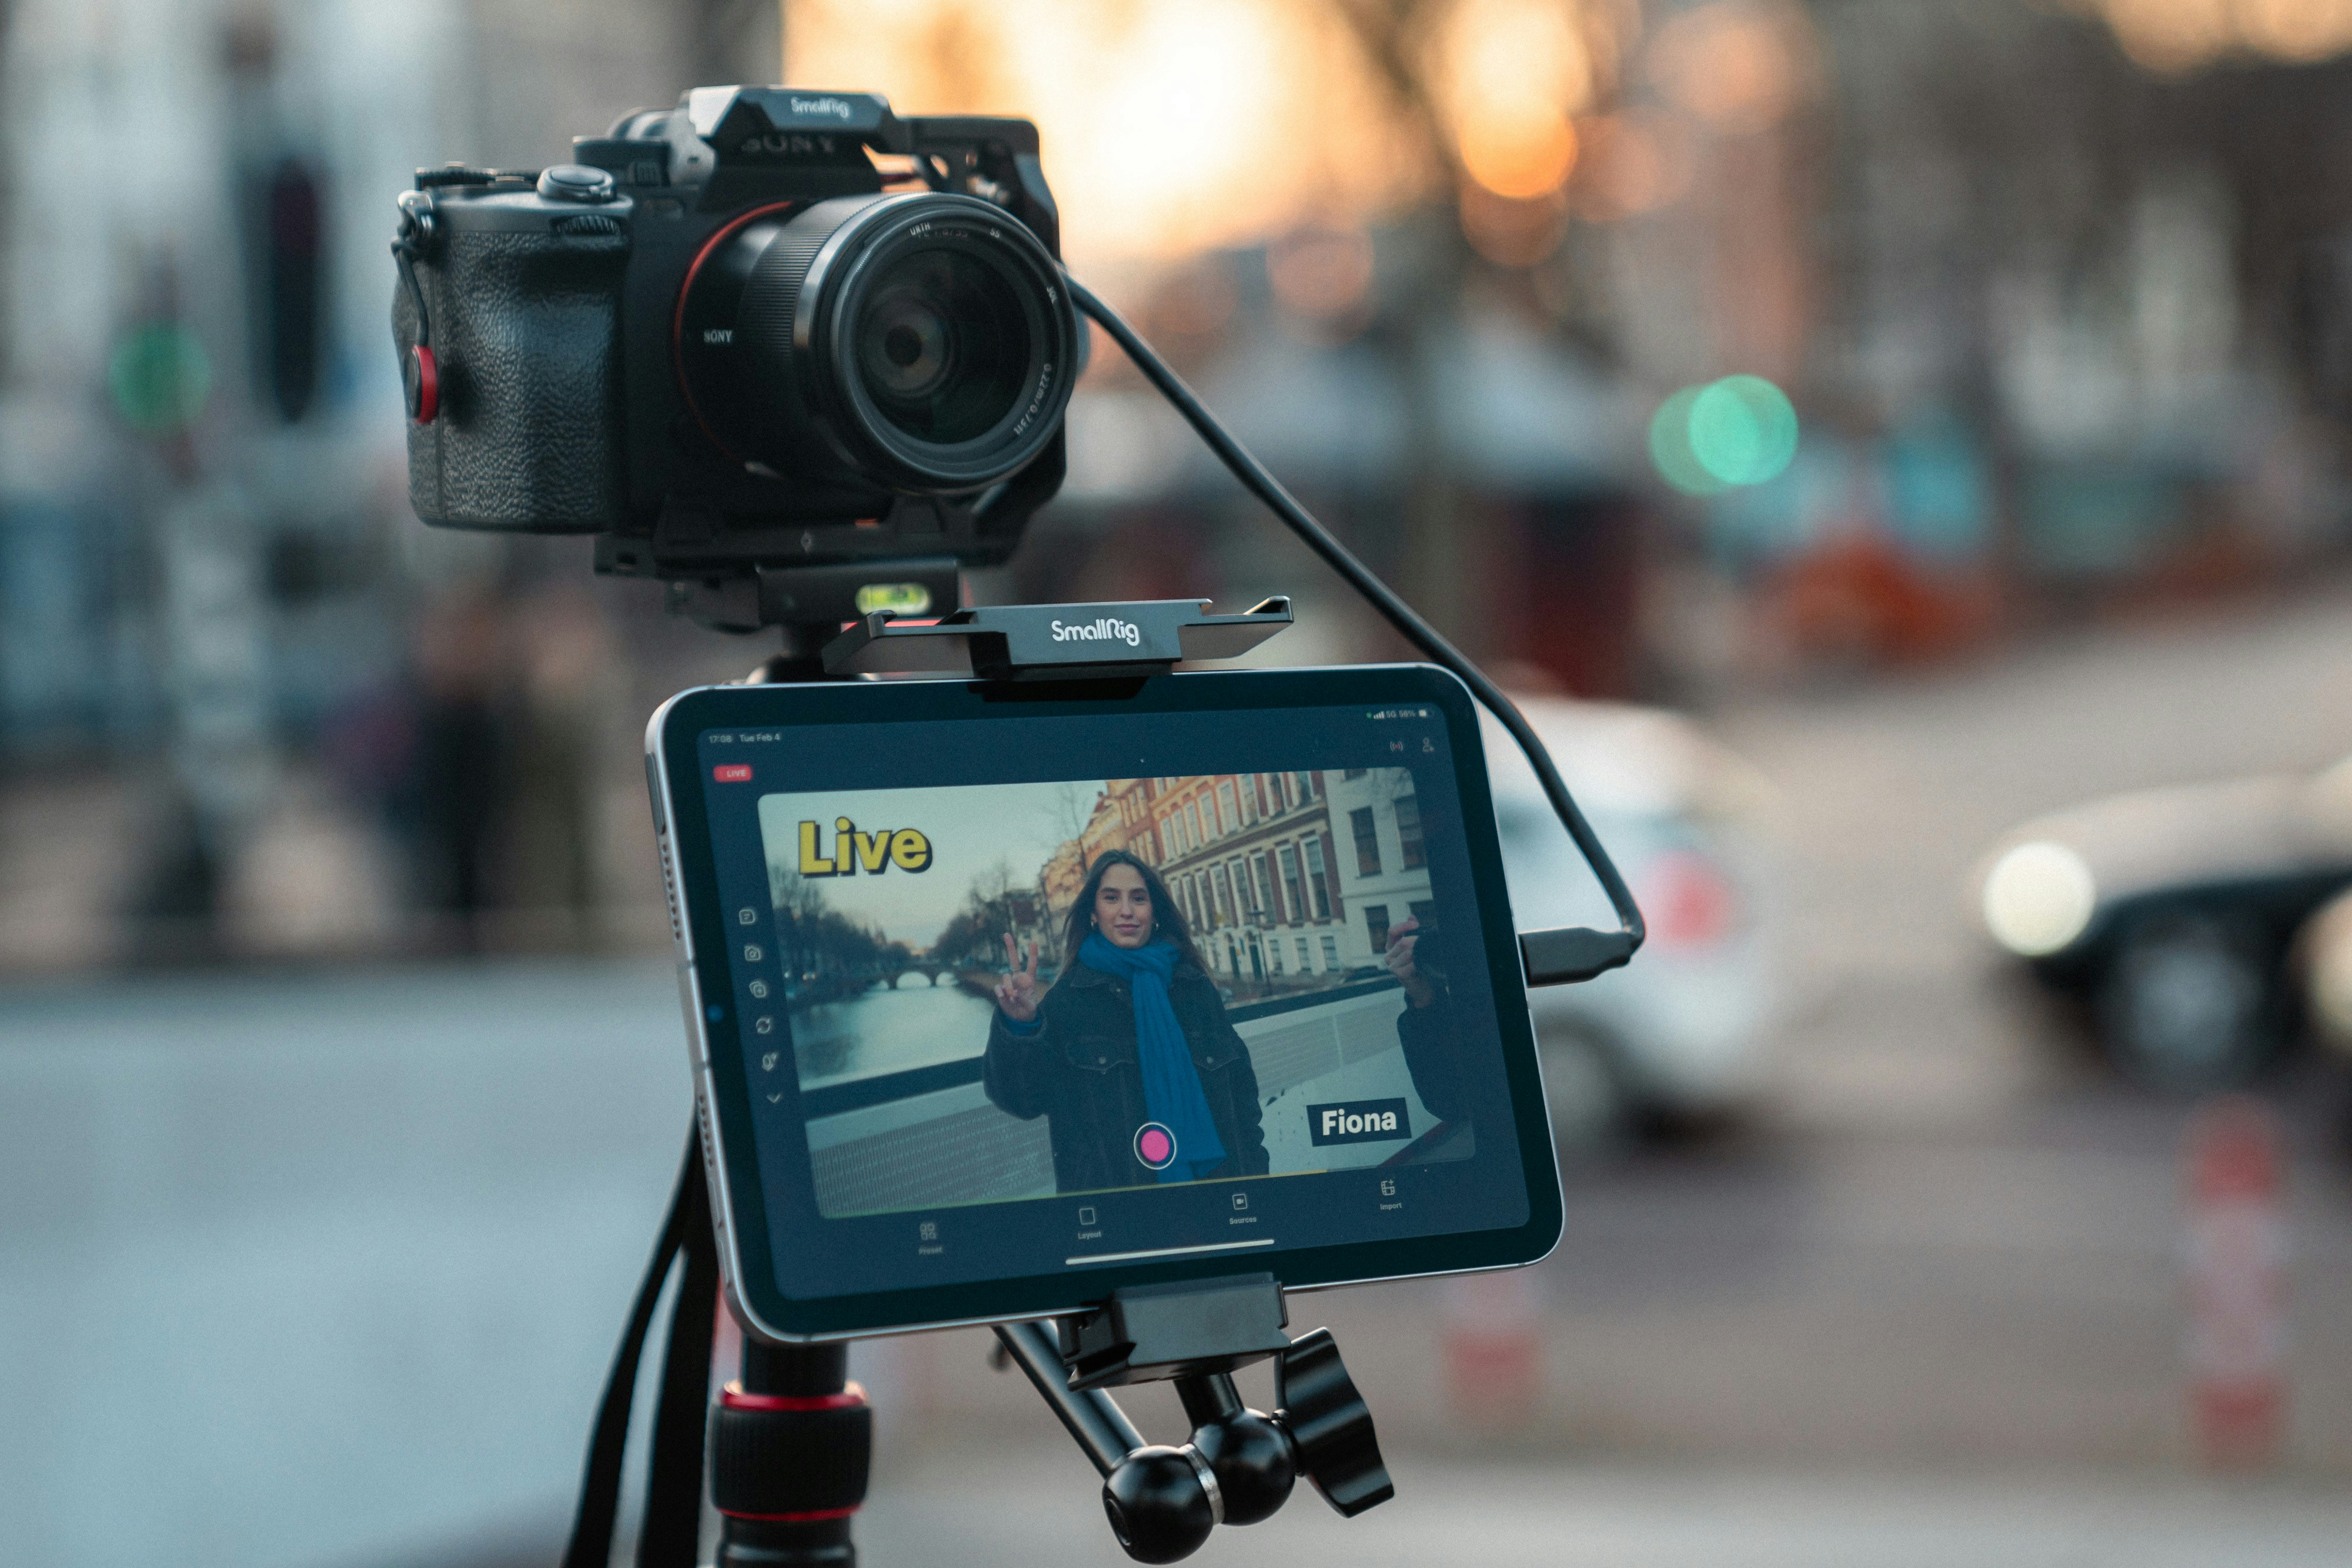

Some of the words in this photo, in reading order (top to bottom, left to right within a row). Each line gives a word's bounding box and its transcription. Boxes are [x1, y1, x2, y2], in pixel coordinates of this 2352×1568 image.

[791, 96, 849, 118] SmallRig
[910, 222, 931, 236] URTH
[704, 329, 733, 343] SONY
[1051, 618, 1140, 646] SmallRig
[756, 733, 772, 741] Feb
[774, 733, 780, 741] 4
[799, 816, 933, 878] Live
[1322, 1108, 1397, 1136] Fiona
[1078, 1231, 1101, 1239] Layout
